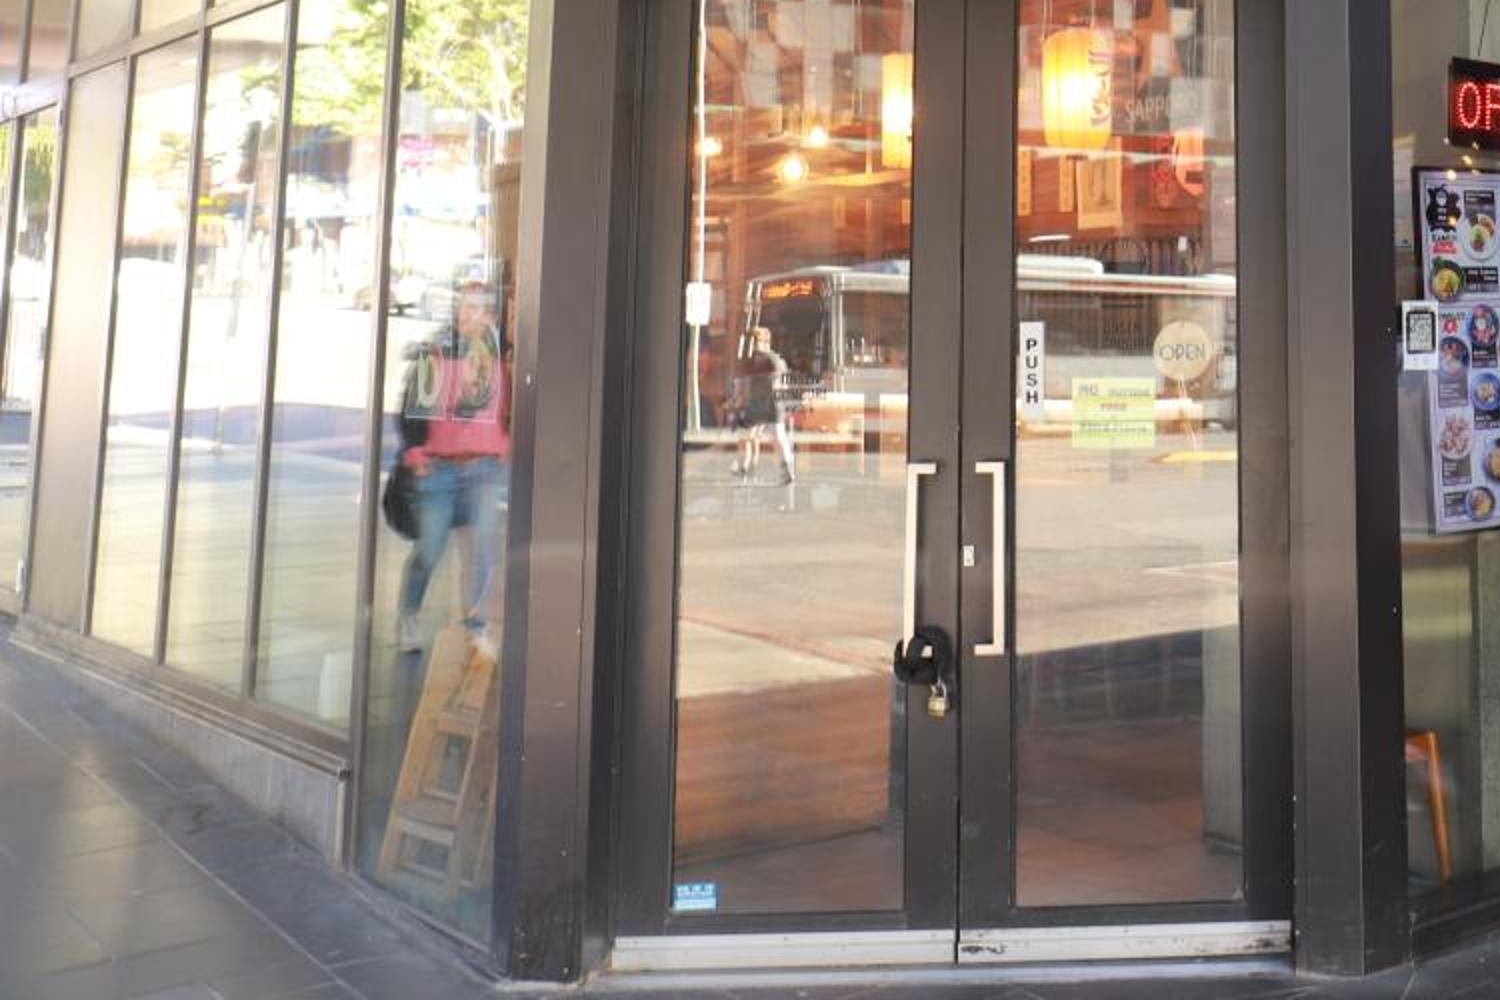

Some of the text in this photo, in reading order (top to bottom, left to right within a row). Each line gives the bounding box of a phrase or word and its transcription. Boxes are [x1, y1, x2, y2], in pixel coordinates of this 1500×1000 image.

[1124, 92, 1199, 123] SAPPO
[1159, 344, 1207, 362] OPEN
[1025, 337, 1039, 405] PUSH
